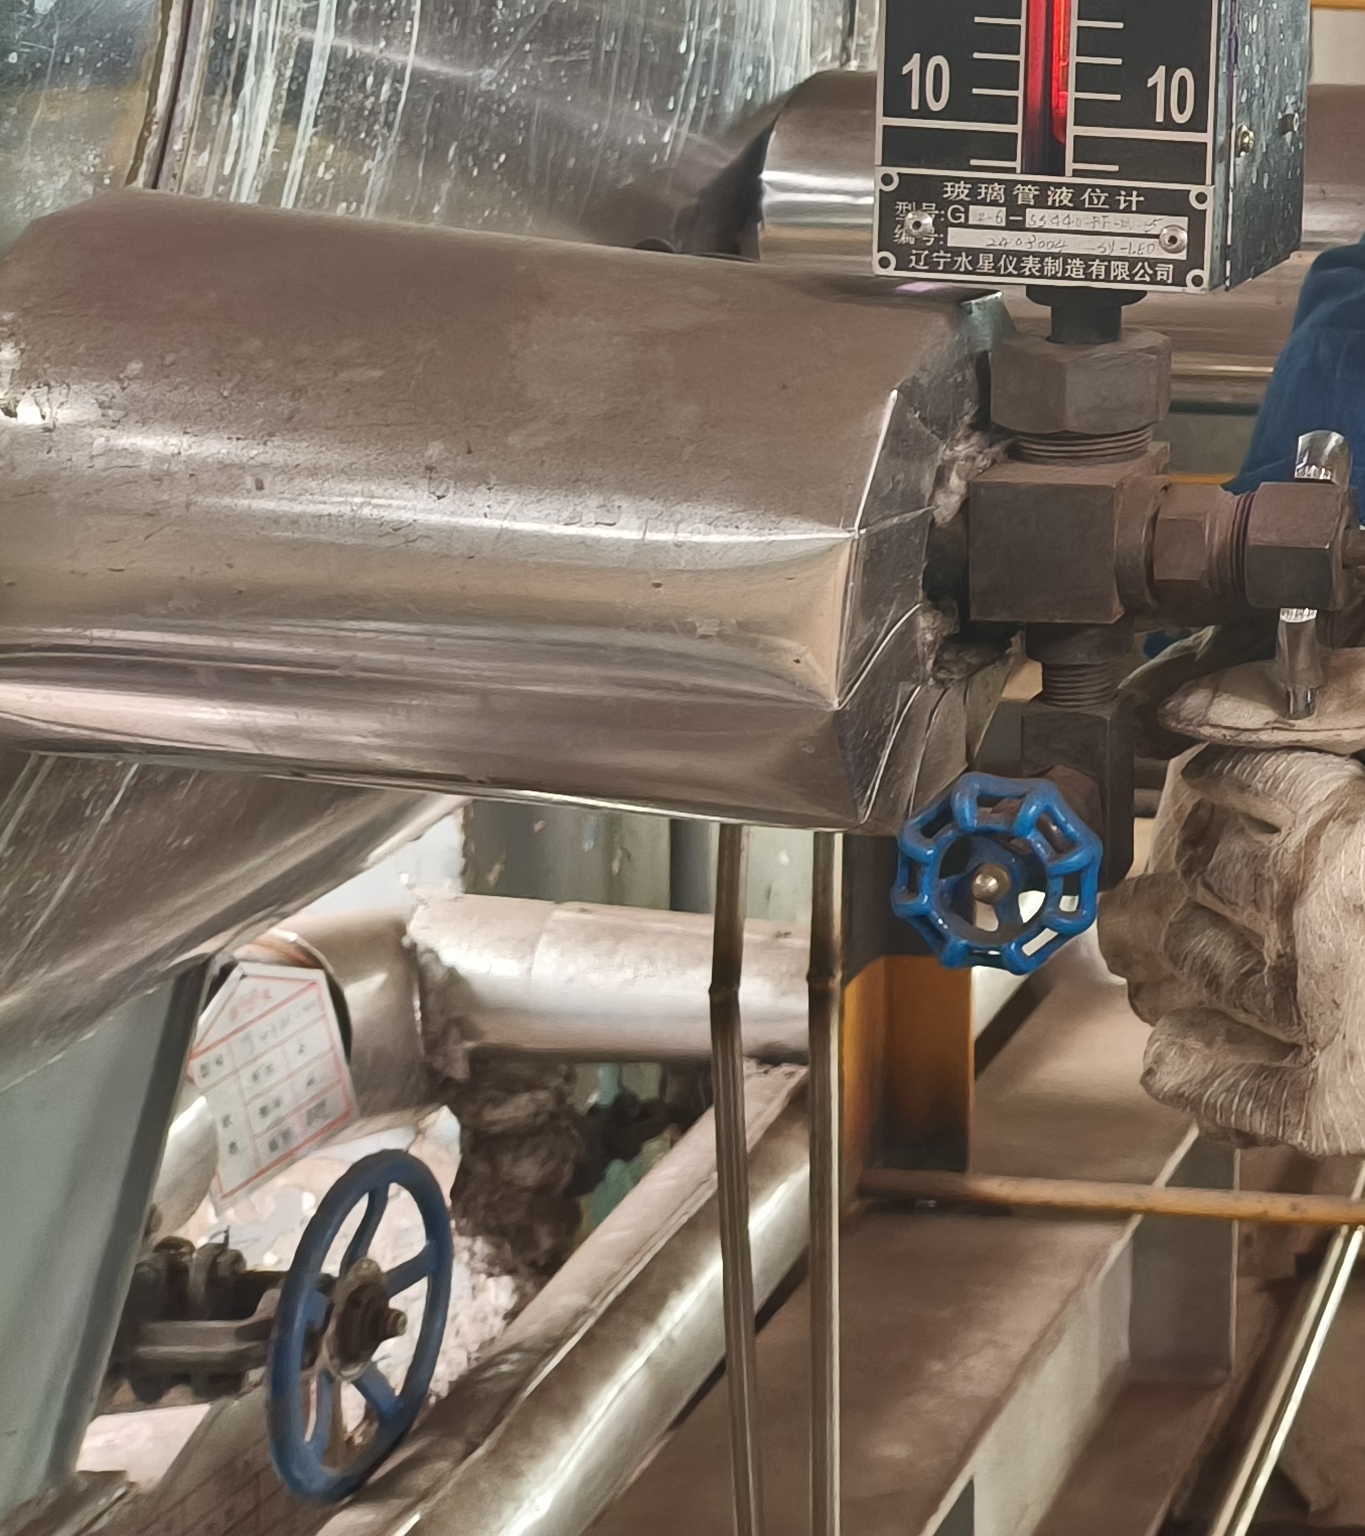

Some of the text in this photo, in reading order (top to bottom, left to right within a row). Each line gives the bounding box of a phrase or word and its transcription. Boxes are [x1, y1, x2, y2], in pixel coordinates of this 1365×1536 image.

[901, 53, 1195, 124] 10 10
[943, 181, 1145, 212] 玻璃管液位计
[908, 249, 1175, 284] 辽宁水星仪表制造有限公司
